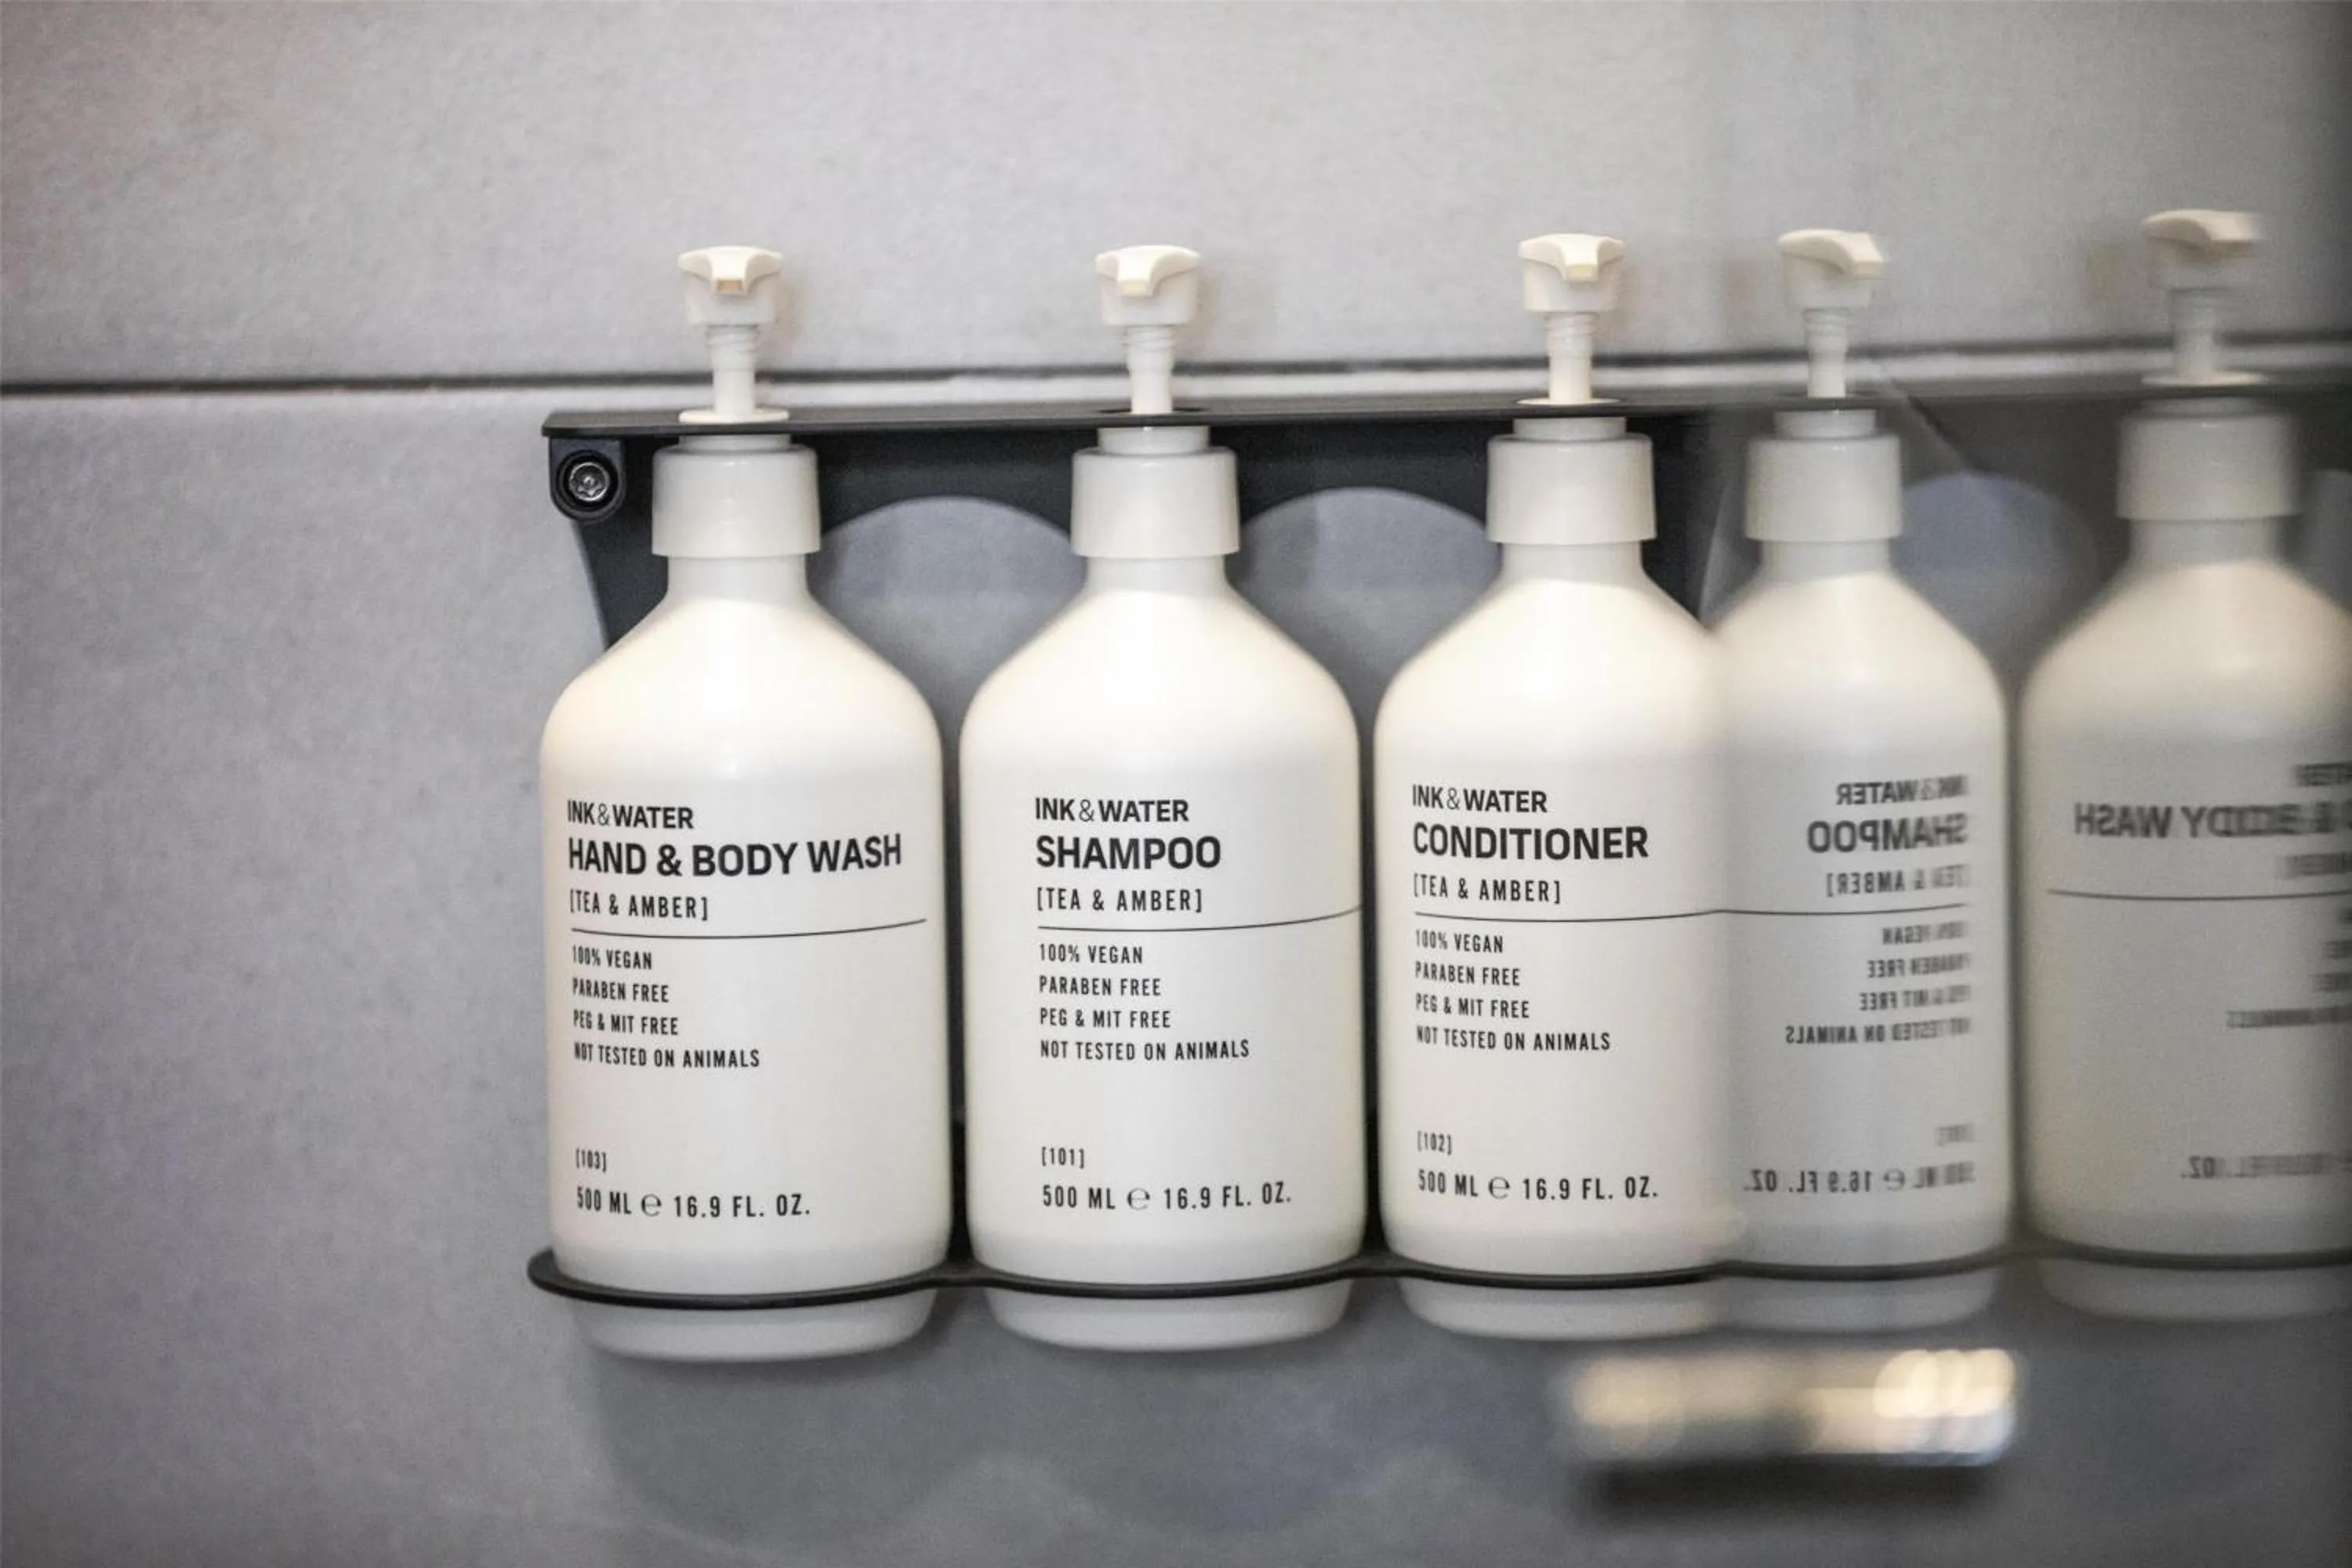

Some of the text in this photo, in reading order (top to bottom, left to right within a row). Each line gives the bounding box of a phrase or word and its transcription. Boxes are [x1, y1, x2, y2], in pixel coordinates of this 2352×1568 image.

[1037, 836, 1220, 869] SHAMPOO
[1414, 822, 1648, 860] CONDITIONER
[569, 834, 901, 877] HAND & BODY WASH
[1038, 887, 1201, 913] [TEA & AMBER]
[1414, 873, 1559, 904] [TEA & AMBER]
[571, 889, 707, 920] [TEA & AMBER]
[1040, 944, 1142, 964] 100% VEGAN
[1417, 930, 1502, 953] 100% VEGAN
[573, 946, 652, 969] 100% VEGAN
[1040, 975, 1160, 996] PARABEN FREE
[1416, 962, 1519, 985] PARABEN FREE
[573, 978, 668, 1003] PARABEN FREE
[1040, 1007, 1170, 1028] PEG & MIT FREE
[1417, 993, 1529, 1018] PEG & MIT FREE
[574, 1010, 677, 1035] PEG & MIT FREE
[1041, 1040, 1248, 1060] NOT TESTED ON ANIMALS
[1417, 1026, 1610, 1051] NOT TESTED ON ANIMALS
[575, 1043, 759, 1067] NOT TESTED ON ANIMALS
[1417, 1131, 1451, 1155] [102]
[576, 1149, 606, 1172] [103]
[1042, 1147, 1083, 1168] [101]
[1044, 1185, 1076, 1207] 500
[1089, 1188, 1115, 1209] ML
[1165, 1187, 1210, 1209] 16.9
[1223, 1185, 1250, 1207] FL.
[1262, 1181, 1290, 1204] OZ.
[1419, 1170, 1446, 1193] 500
[1455, 1174, 1478, 1196] ML
[1524, 1178, 1570, 1200] 16.9
[1583, 1178, 1612, 1200] FL.
[1625, 1176, 1657, 1198] OZ.
[577, 1187, 601, 1211] 500
[610, 1192, 631, 1214] ML
[675, 1196, 720, 1218] 16.9
[733, 1196, 764, 1217] FL.
[777, 1194, 809, 1216] OZ.
